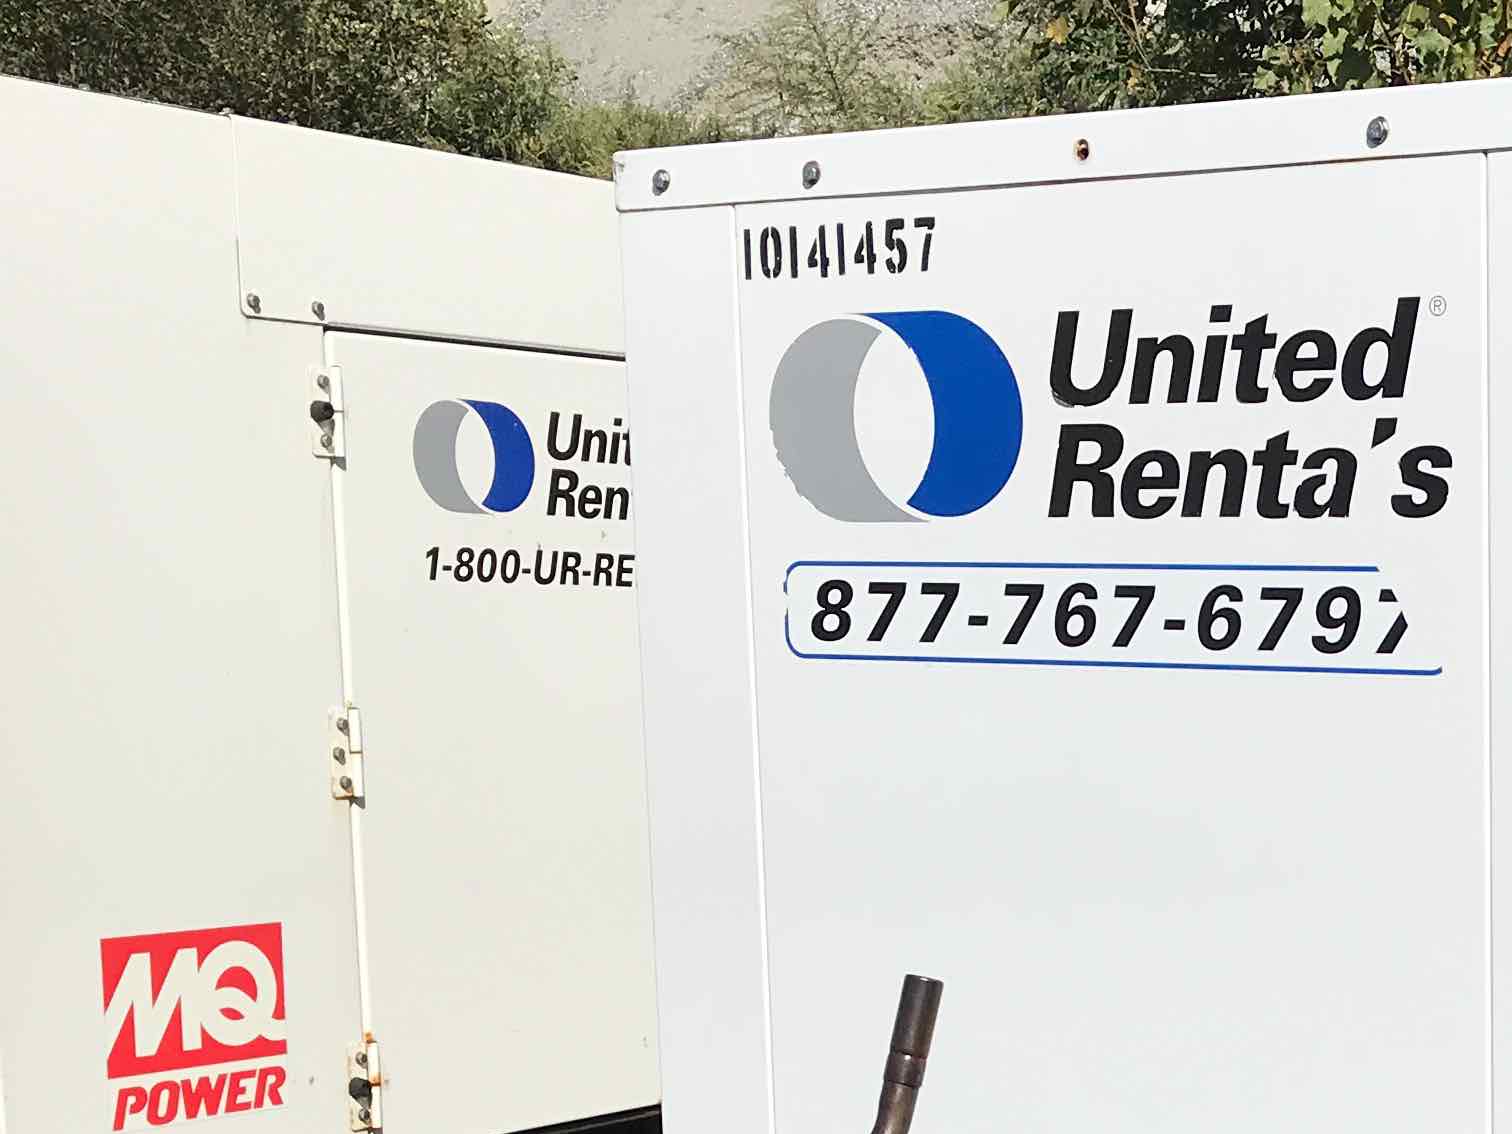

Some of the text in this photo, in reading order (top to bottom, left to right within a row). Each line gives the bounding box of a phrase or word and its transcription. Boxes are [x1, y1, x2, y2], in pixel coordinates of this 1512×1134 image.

[744, 216, 936, 280] 10141457
[1050, 297, 1421, 407] United
[103, 940, 288, 1058] MQ
[112, 1066, 286, 1132] POWER
